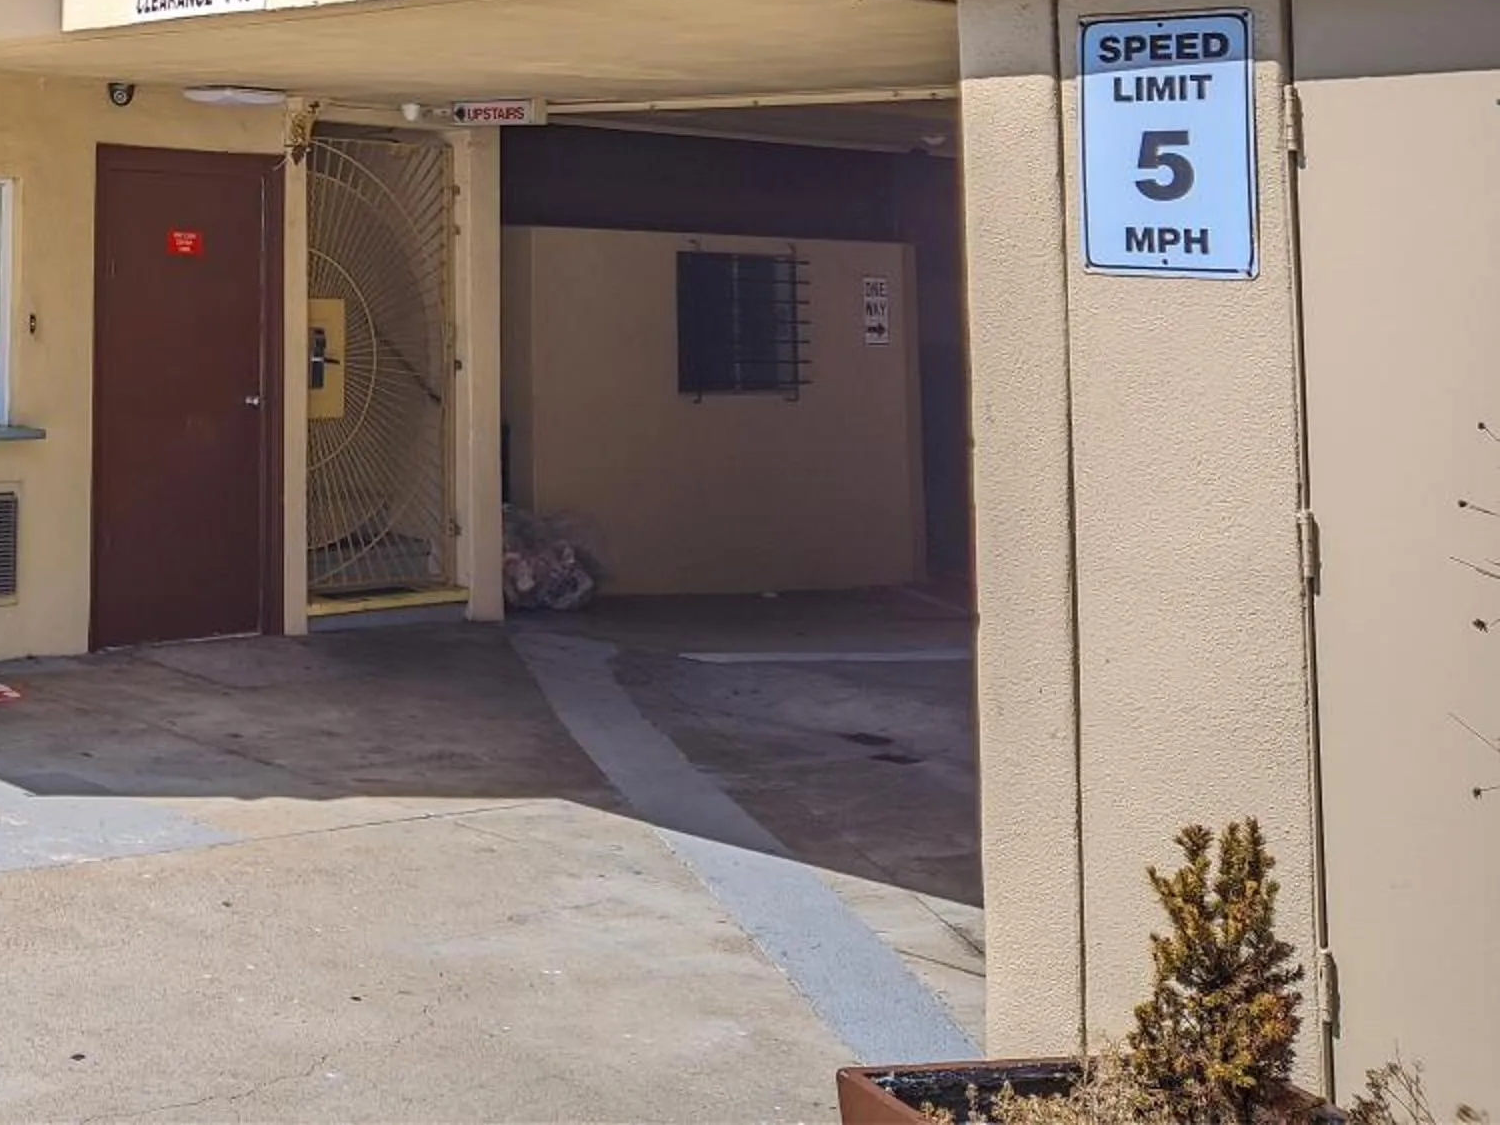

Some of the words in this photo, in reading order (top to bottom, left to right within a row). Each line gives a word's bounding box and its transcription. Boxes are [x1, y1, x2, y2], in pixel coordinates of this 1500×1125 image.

[1098, 32, 1230, 63] SPEED
[1113, 74, 1213, 102] LIMIT
[467, 106, 524, 120] UPSTAIRS
[1135, 130, 1194, 202] 5
[1125, 227, 1210, 255] MPH
[865, 301, 886, 316] WAY
